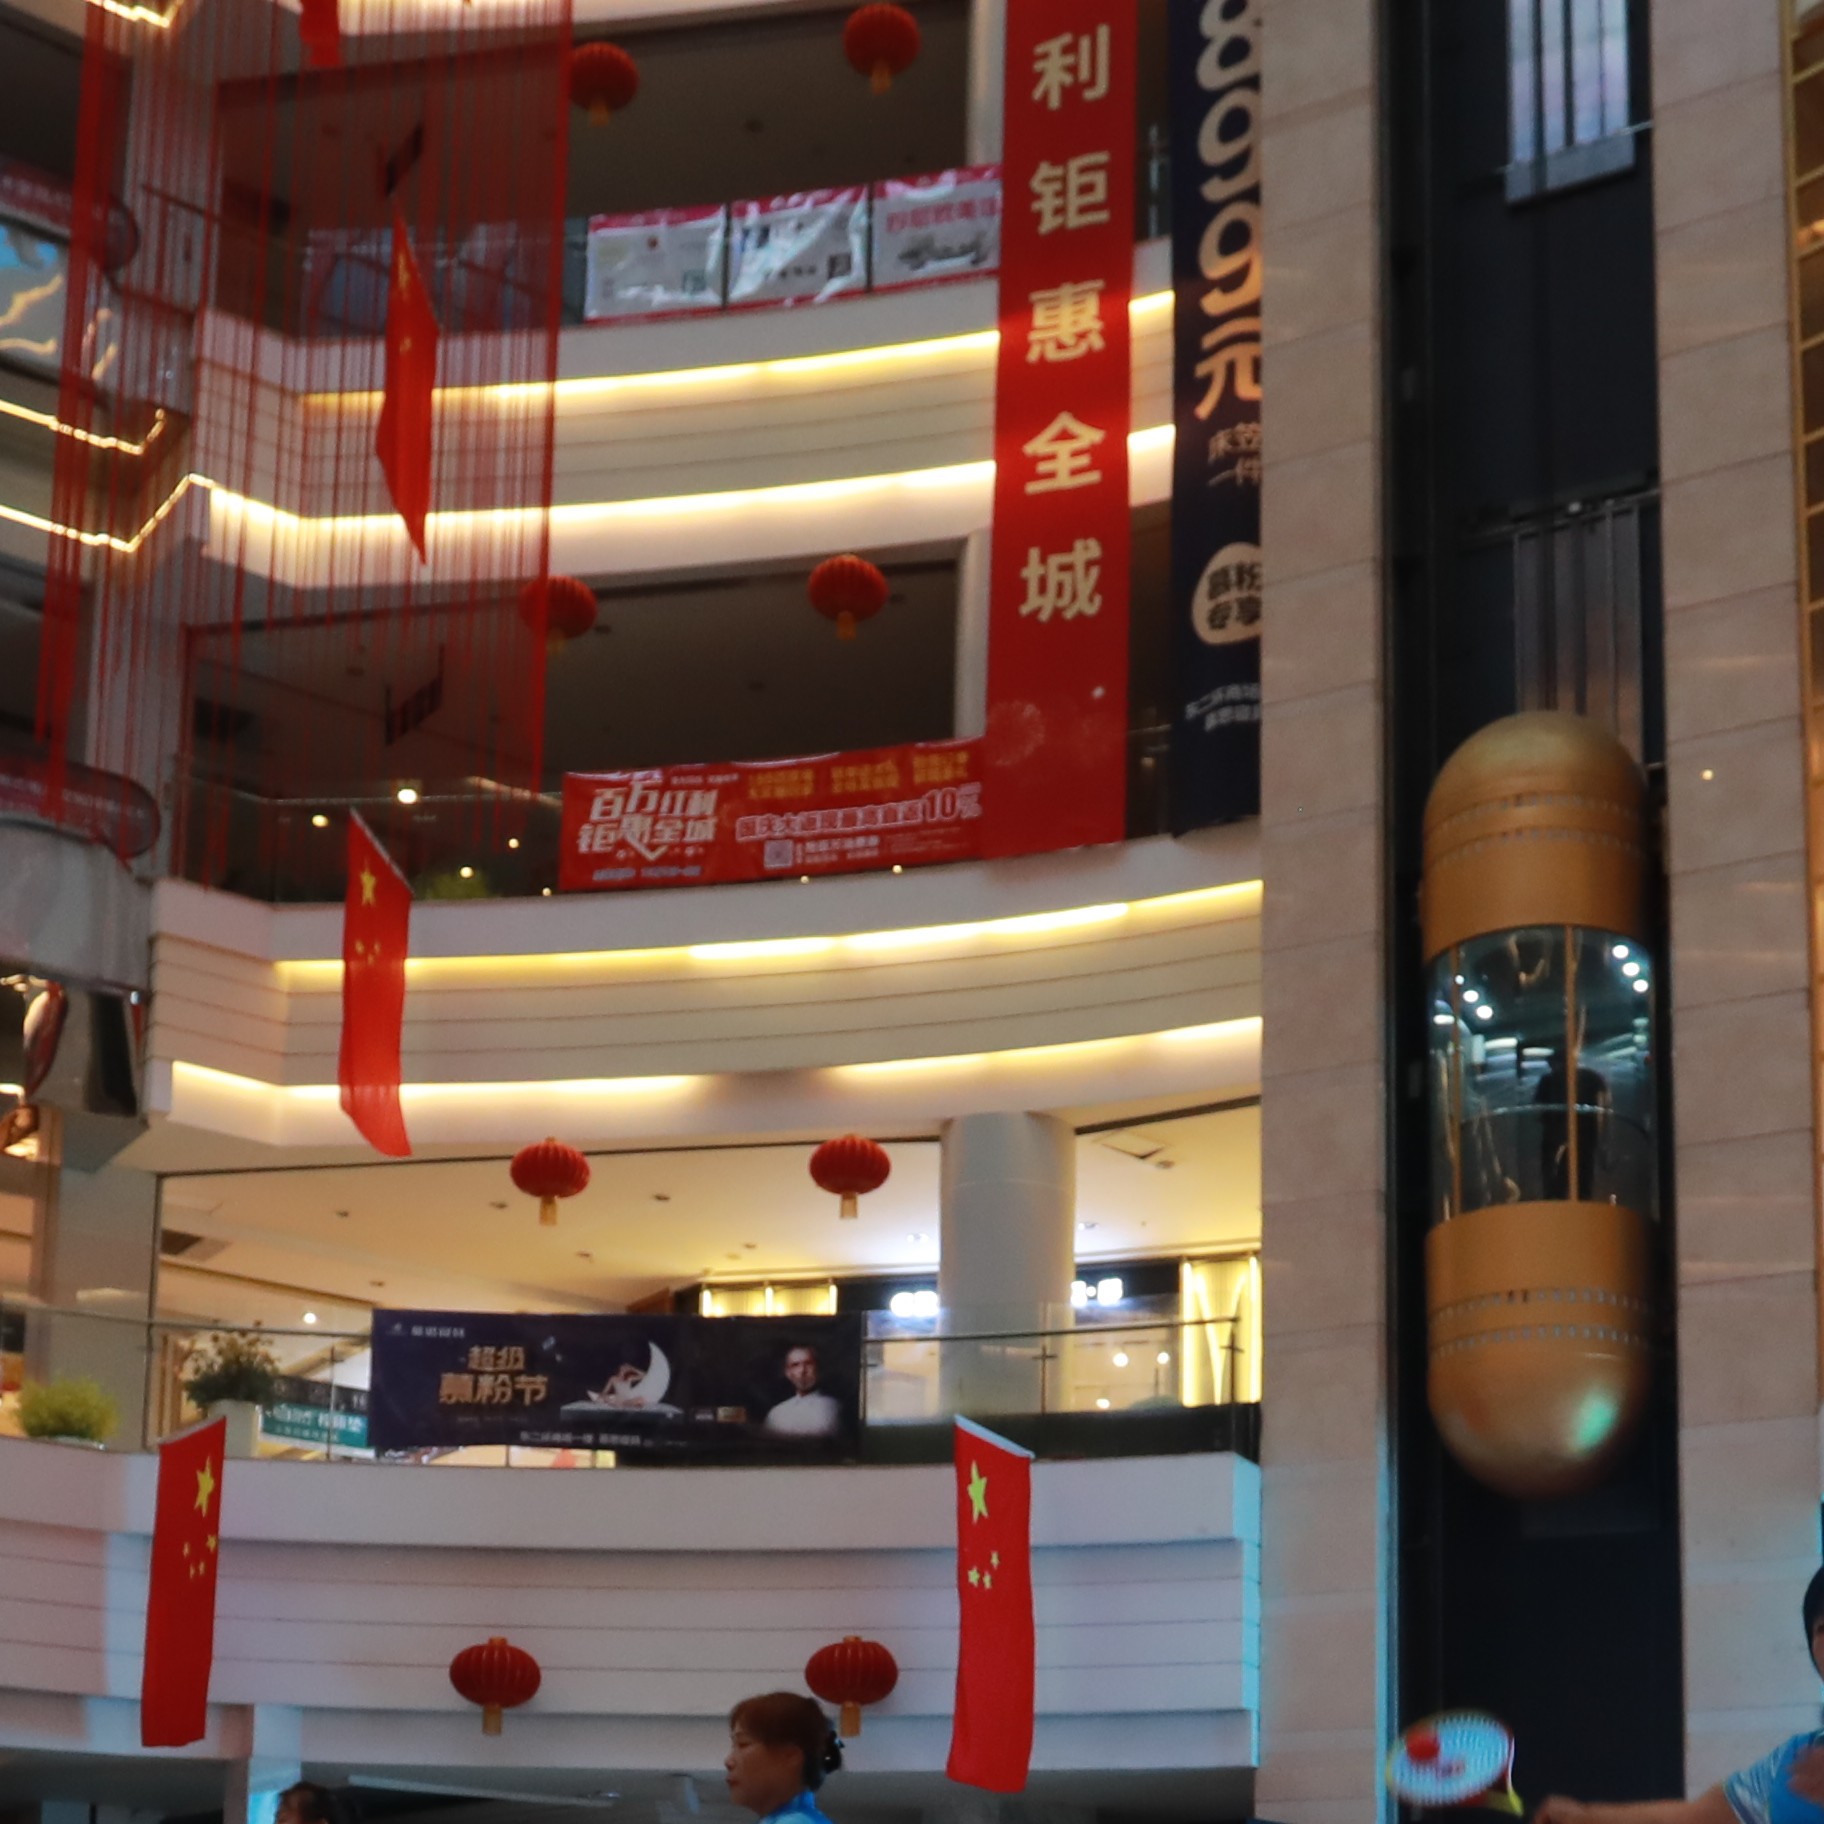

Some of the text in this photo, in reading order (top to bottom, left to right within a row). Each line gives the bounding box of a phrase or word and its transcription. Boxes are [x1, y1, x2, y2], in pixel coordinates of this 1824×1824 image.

[1019, 23, 1112, 623] 利钜惠全城
[466, 1345, 526, 1372] 超级
